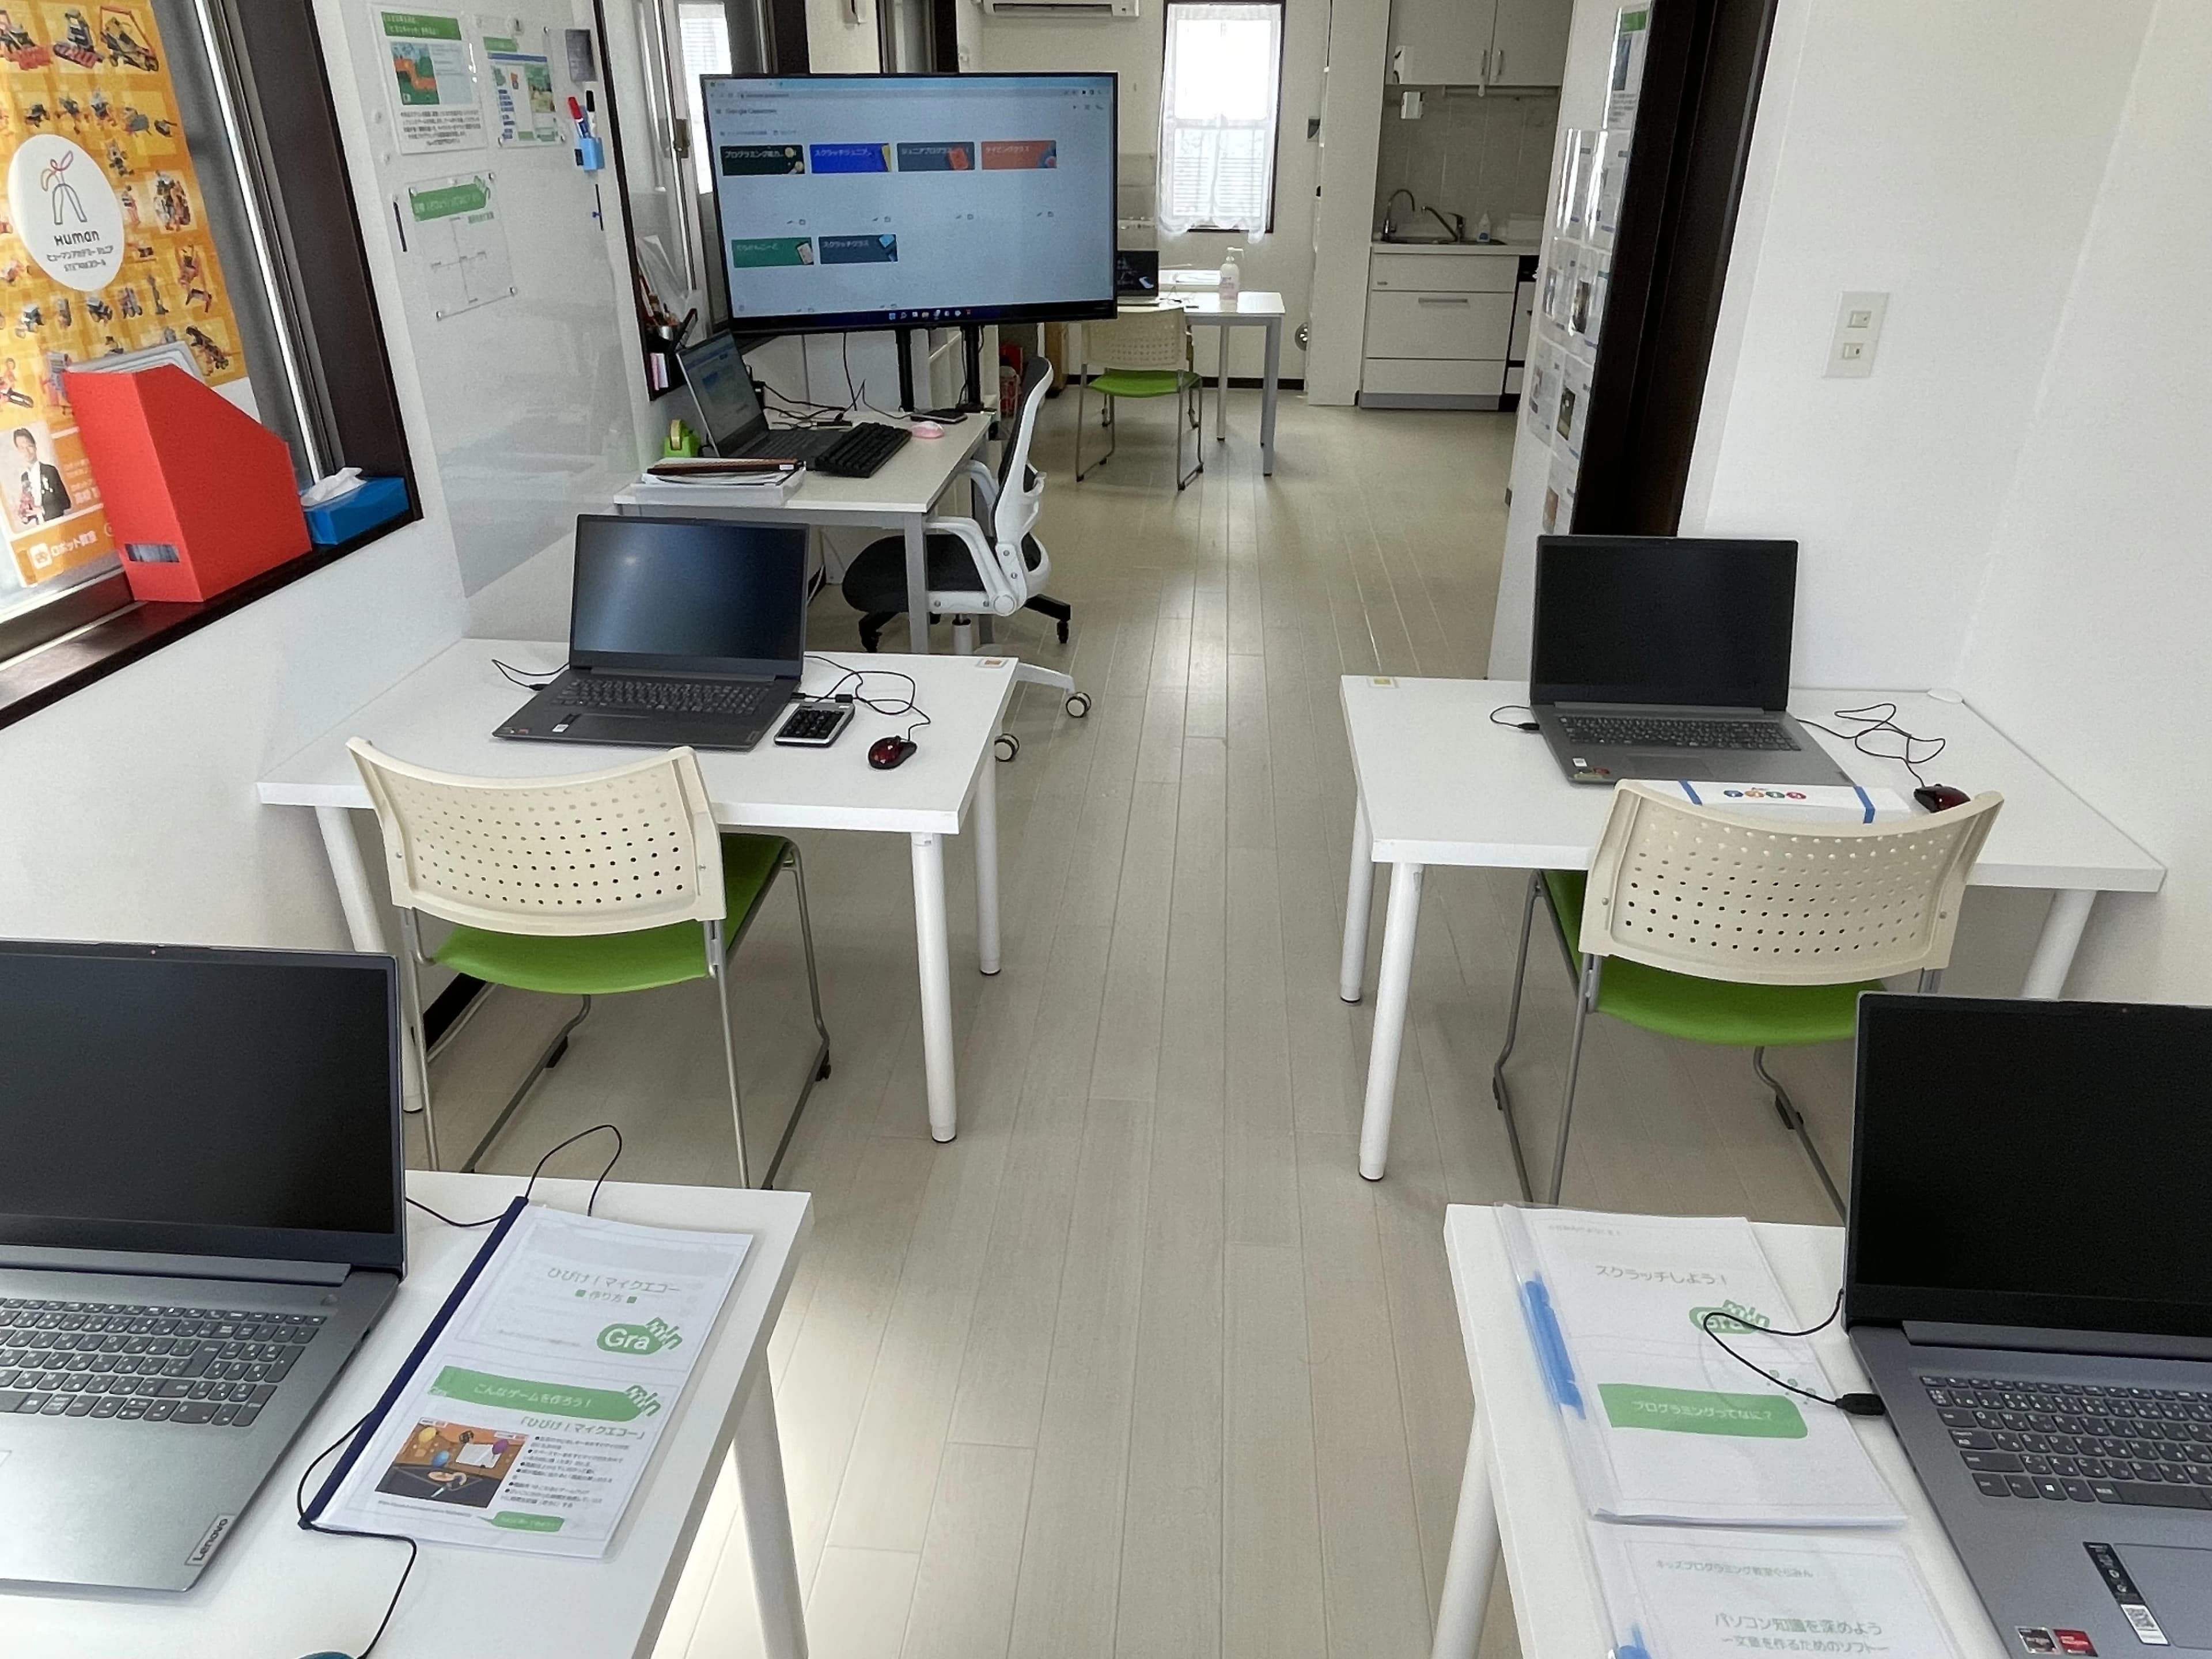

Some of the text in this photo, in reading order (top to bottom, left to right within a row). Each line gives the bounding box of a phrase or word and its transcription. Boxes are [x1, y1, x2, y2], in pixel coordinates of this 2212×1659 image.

[54, 230, 100, 246] Human
[547, 1267, 681, 1294] ひびけ！マイクエコー
[1595, 1264, 1728, 1286] スクラッチしよう！
[604, 1327, 651, 1351] Gra
[192, 1518, 228, 1561] Lenovo
